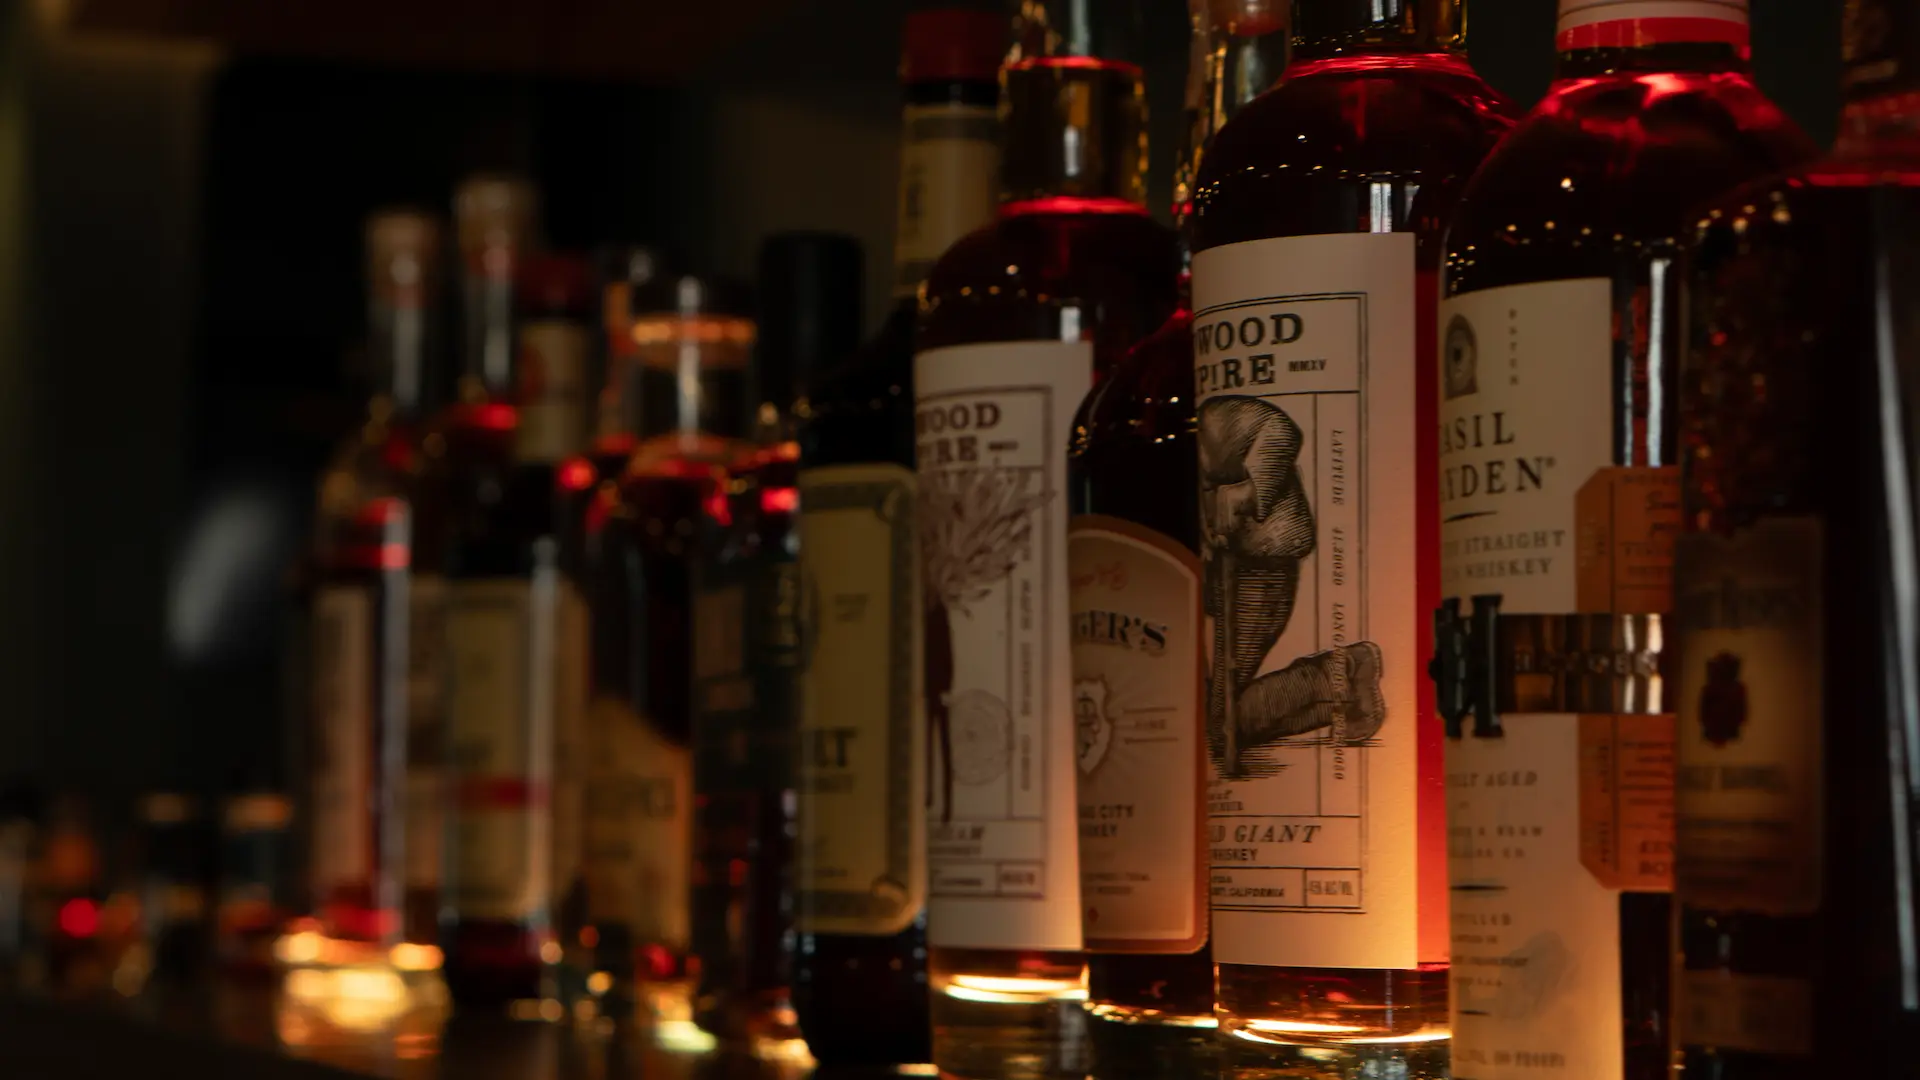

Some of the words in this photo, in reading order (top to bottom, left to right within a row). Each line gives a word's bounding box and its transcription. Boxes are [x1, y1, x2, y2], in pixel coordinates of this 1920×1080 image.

[1331, 429, 1346, 506] LATITUDE
[1464, 529, 1566, 555] STRAIGHT
[1099, 804, 1134, 819] CITY
[1235, 824, 1322, 844] GIANT
